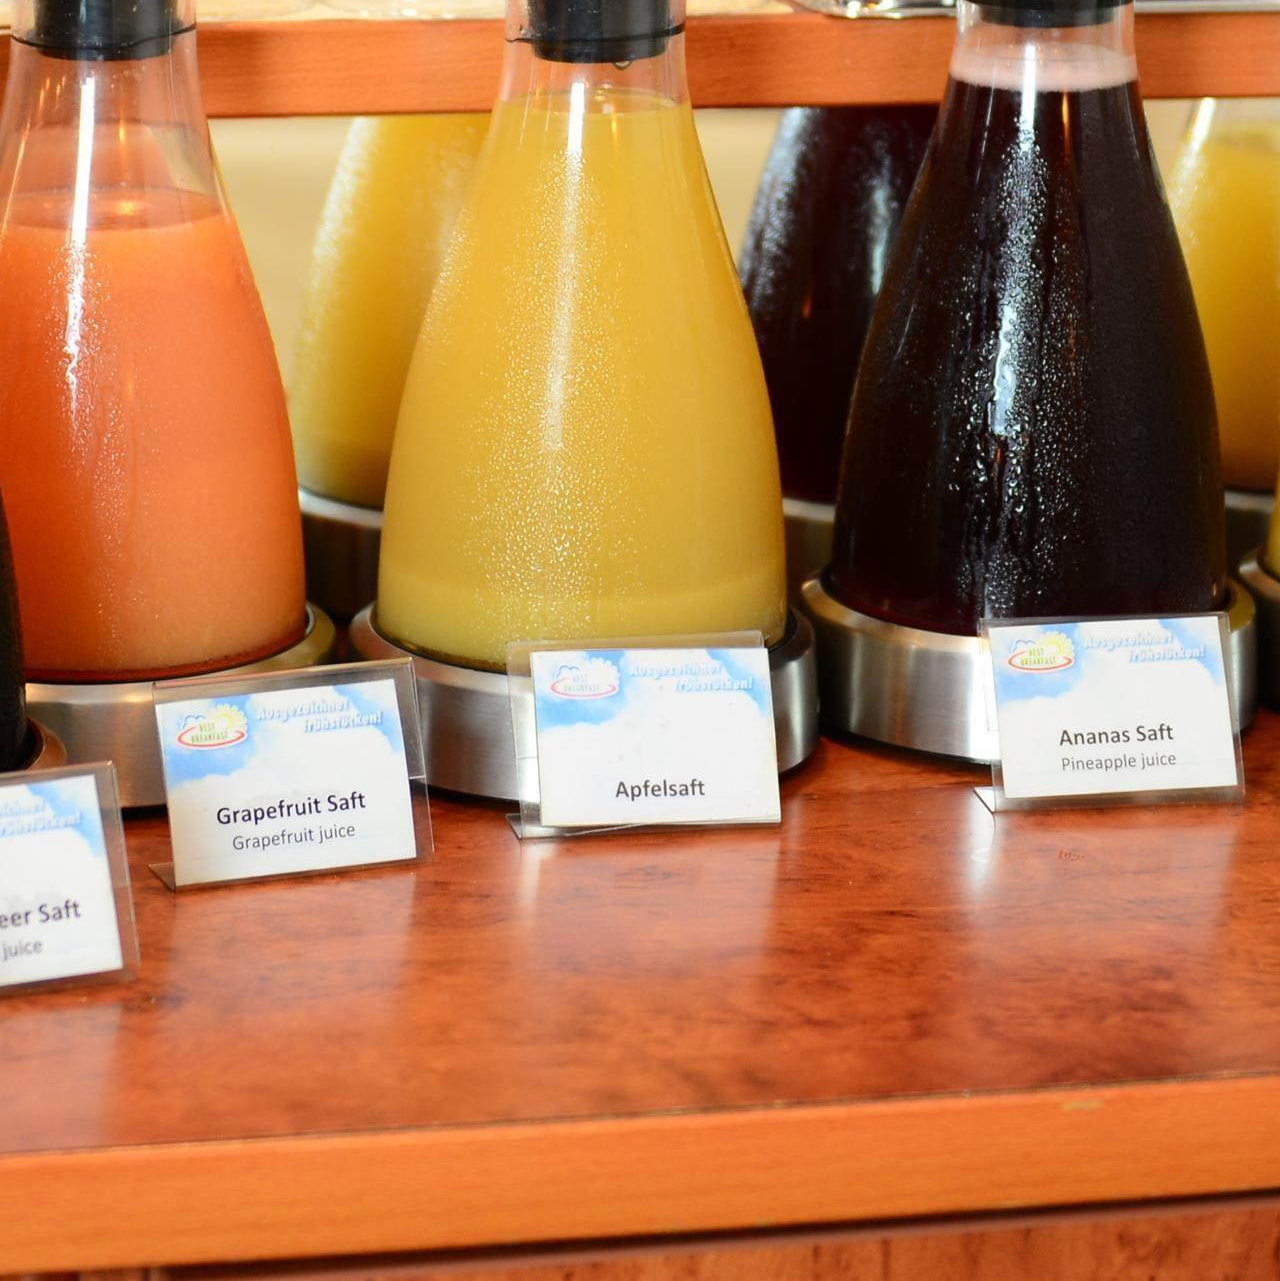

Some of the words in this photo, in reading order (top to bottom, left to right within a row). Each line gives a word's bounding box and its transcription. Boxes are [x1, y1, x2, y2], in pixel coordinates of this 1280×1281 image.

[1059, 728, 1131, 747] Ananas
[1136, 722, 1174, 743] Saft
[1061, 753, 1137, 773] Pineapple
[1140, 752, 1177, 770] juice
[614, 778, 706, 803] Apfelsaft
[216, 797, 322, 827] Grapefruit
[327, 790, 367, 813] Saft
[232, 828, 316, 852] Grapefruit
[319, 823, 356, 845] juice
[37, 899, 82, 924] Saft
[2, 939, 43, 963] juice
